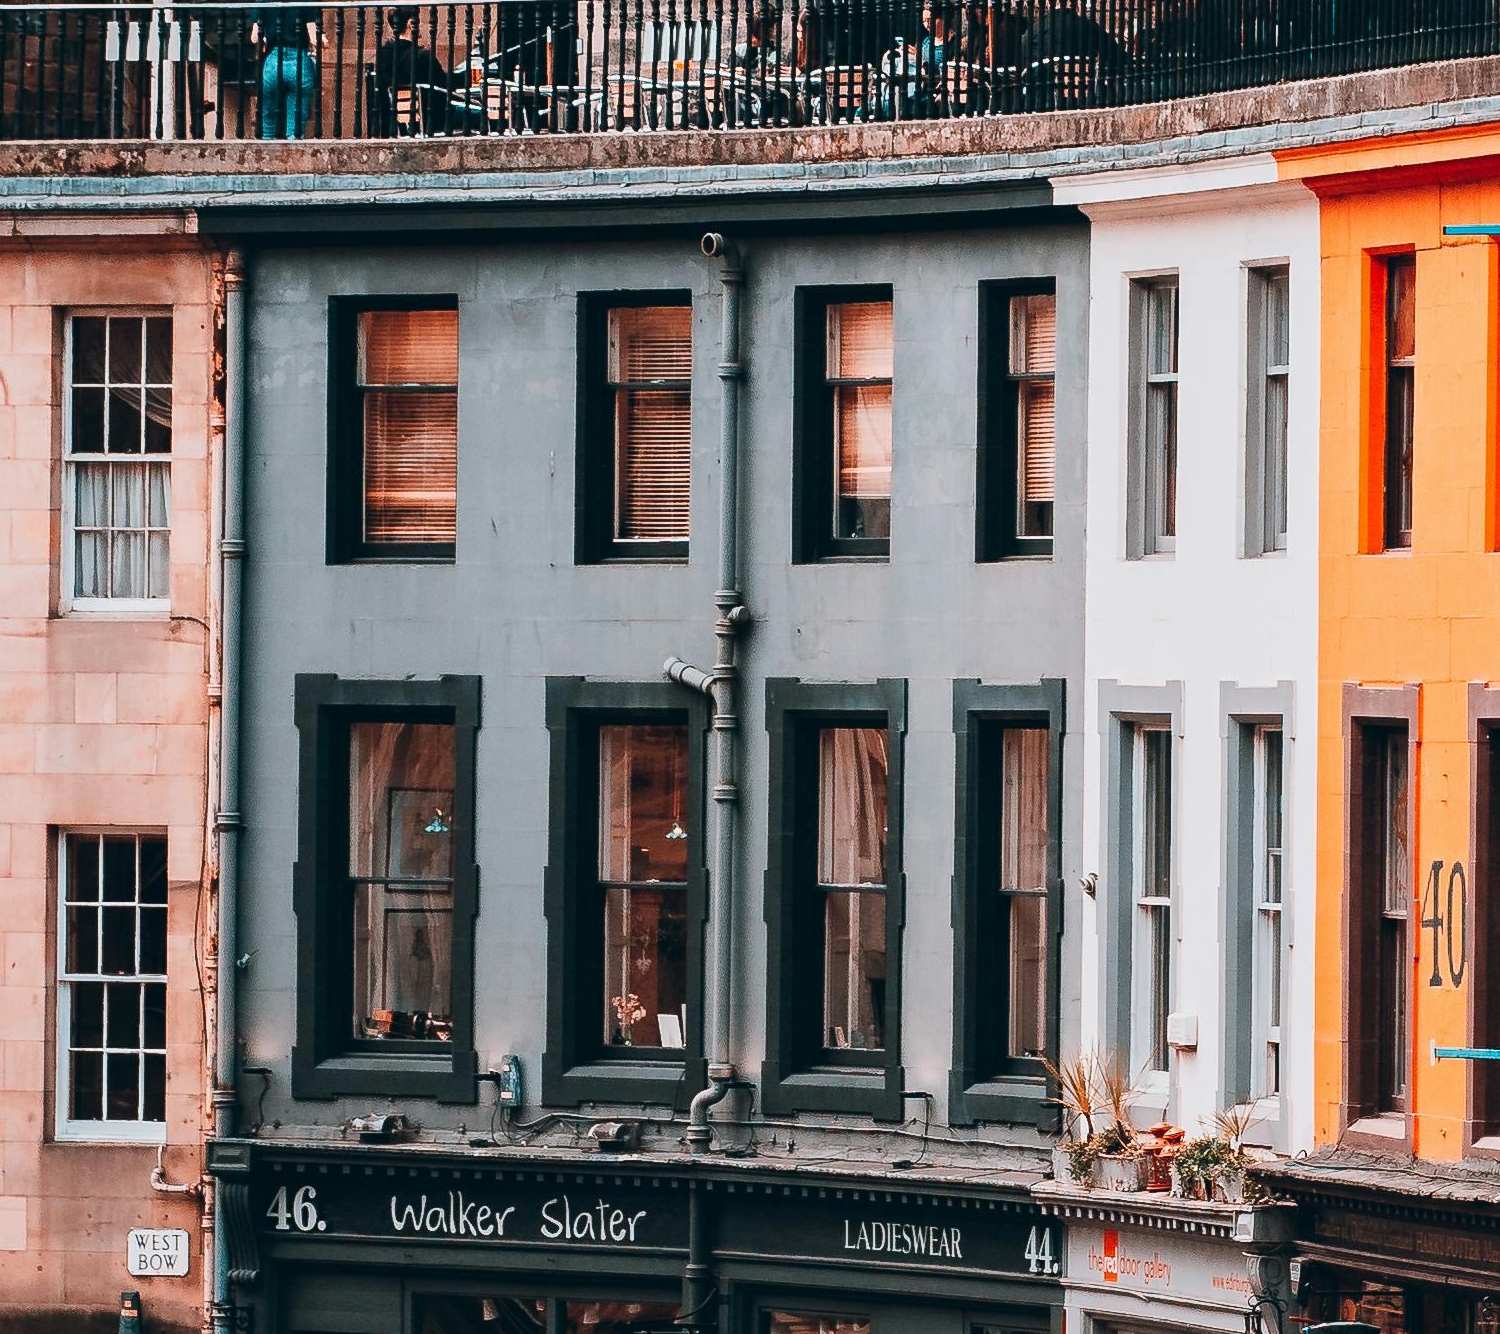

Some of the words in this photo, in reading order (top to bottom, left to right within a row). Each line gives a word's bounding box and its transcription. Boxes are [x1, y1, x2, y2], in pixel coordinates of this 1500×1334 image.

[1422, 861, 1467, 988] 40
[134, 1233, 182, 1251] WEST
[266, 1185, 327, 1232] 46.
[391, 1190, 515, 1236] Walker
[541, 1195, 647, 1242] Slater
[844, 1219, 963, 1259] LADIESWEAR
[1025, 1226, 1059, 1274] 44.
[138, 1253, 179, 1271] BOW
[1144, 1252, 1172, 1287] gallery
